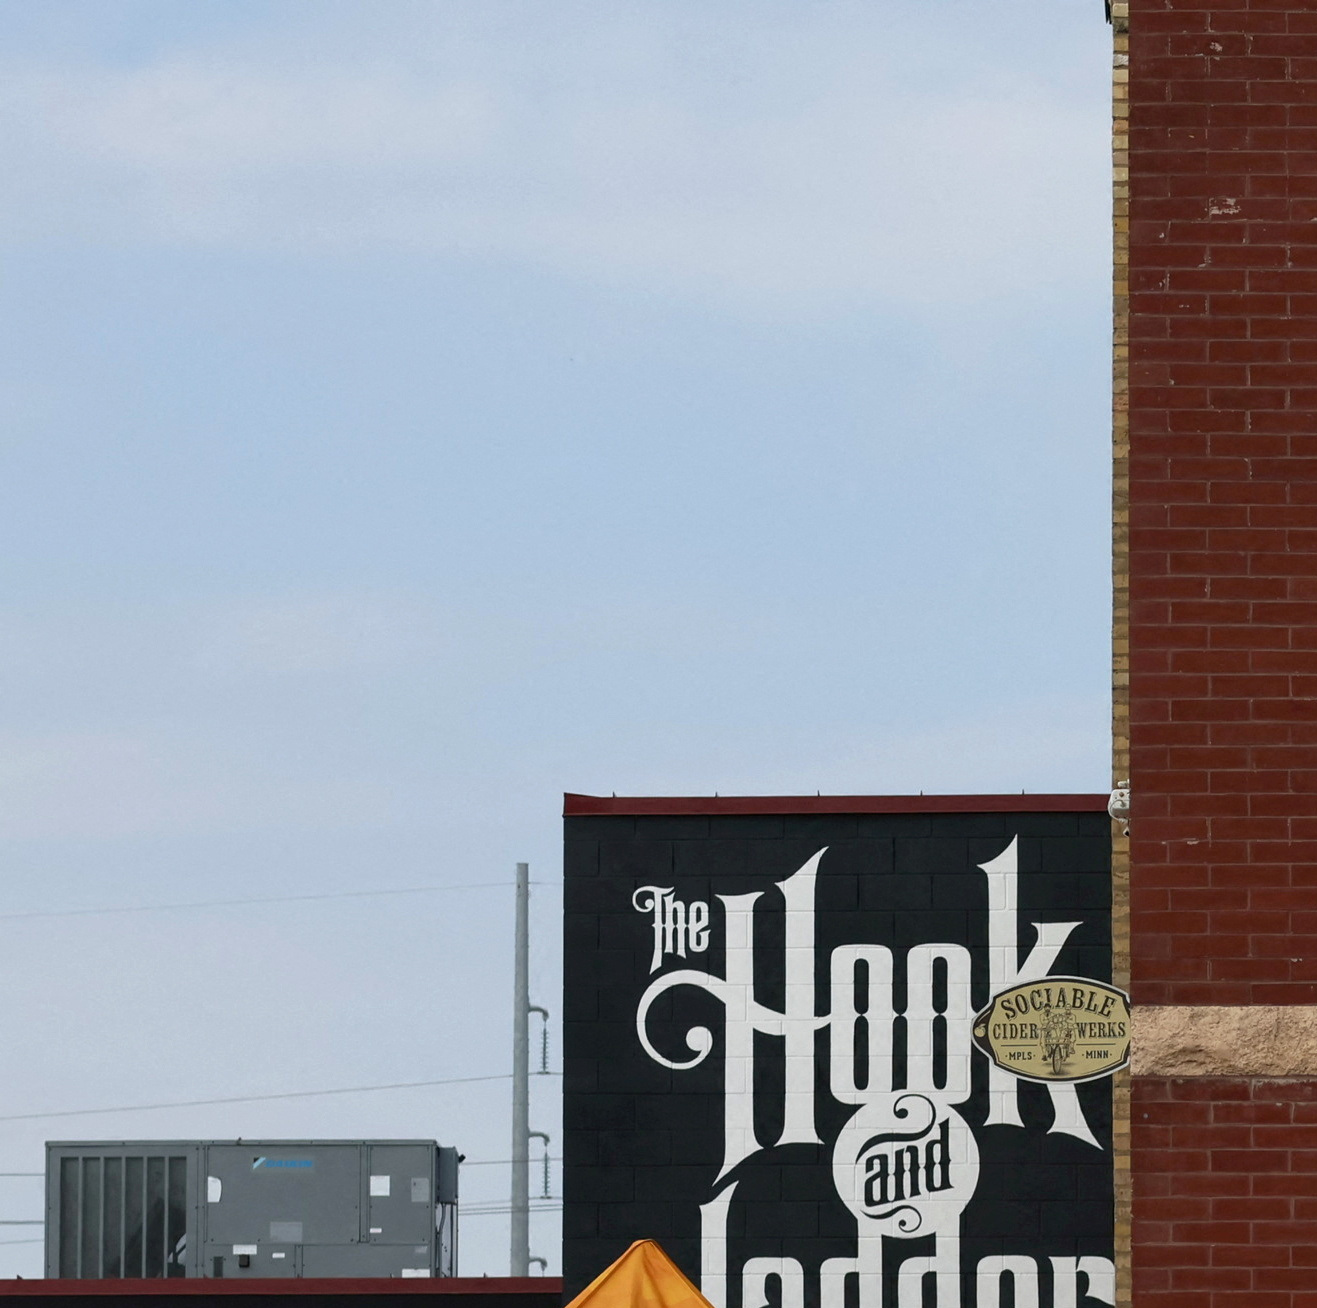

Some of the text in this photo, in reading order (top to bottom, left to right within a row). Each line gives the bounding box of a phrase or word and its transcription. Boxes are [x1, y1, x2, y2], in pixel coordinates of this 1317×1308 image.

[632, 885, 712, 975] The
[636, 833, 1104, 1187] Hook
[992, 1020, 1127, 1041] CIDER WERKS
[1000, 986, 1118, 1021] SOCIABLE
[863, 1117, 953, 1204] and
